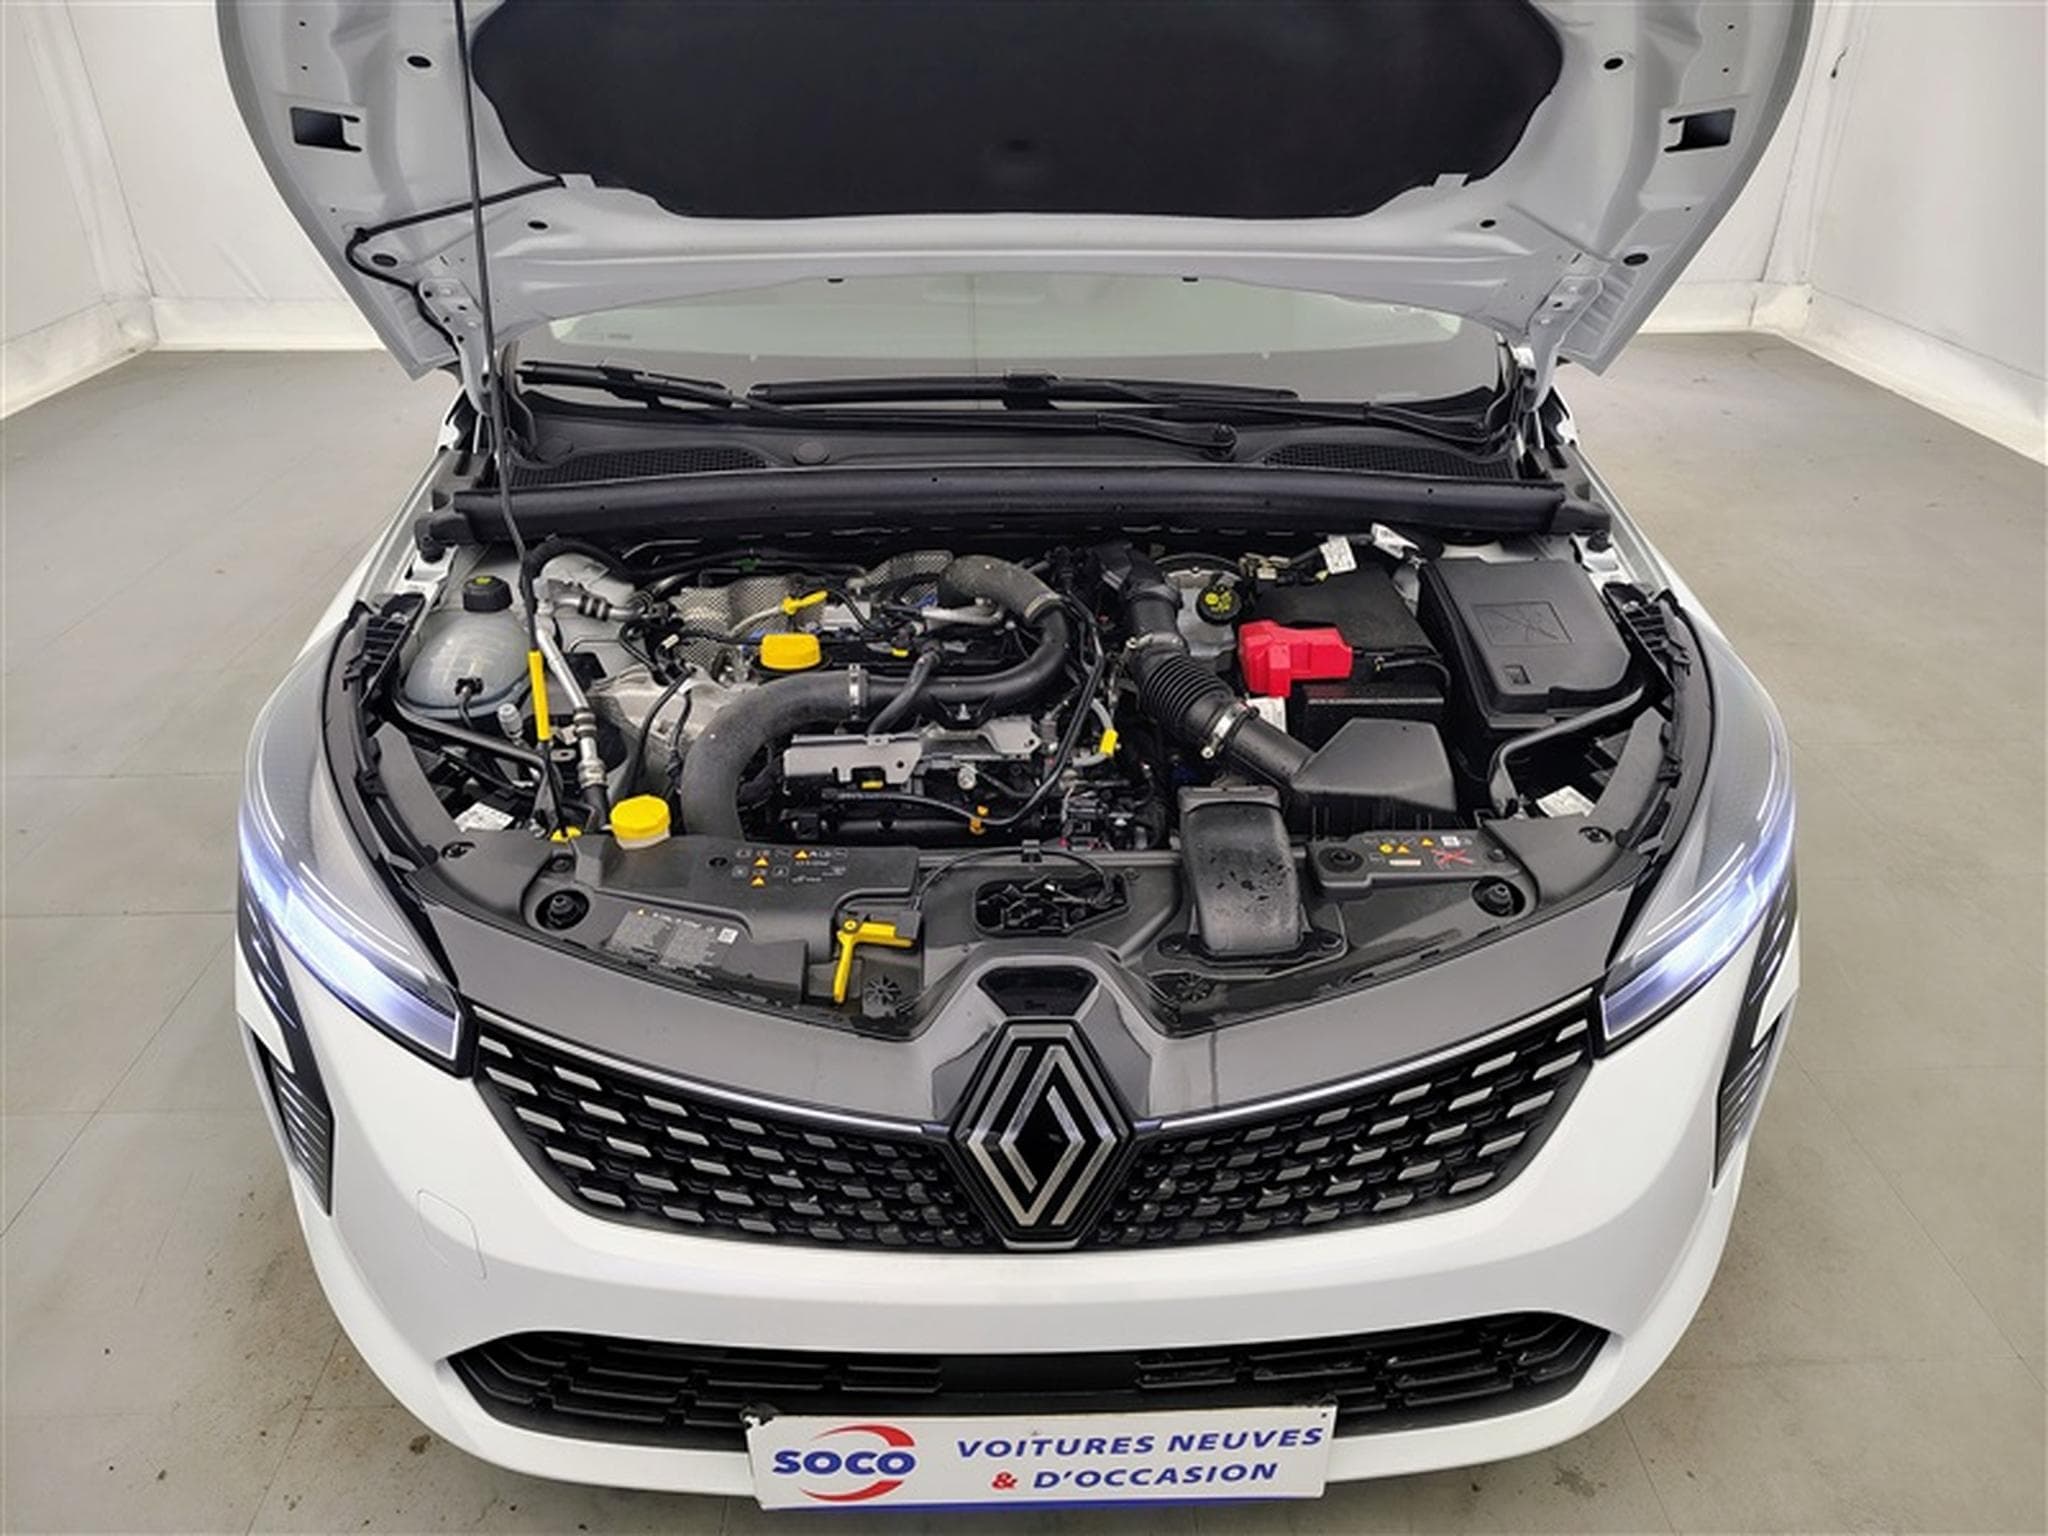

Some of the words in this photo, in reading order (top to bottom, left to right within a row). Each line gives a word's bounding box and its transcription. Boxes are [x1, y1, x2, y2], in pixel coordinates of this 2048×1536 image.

[957, 1435, 1154, 1458] VOITURES
[1167, 1427, 1324, 1452] NEUVES
[773, 1450, 916, 1476] SOCO
[991, 1471, 1018, 1489] &
[1033, 1462, 1278, 1489] D'OCCASION
